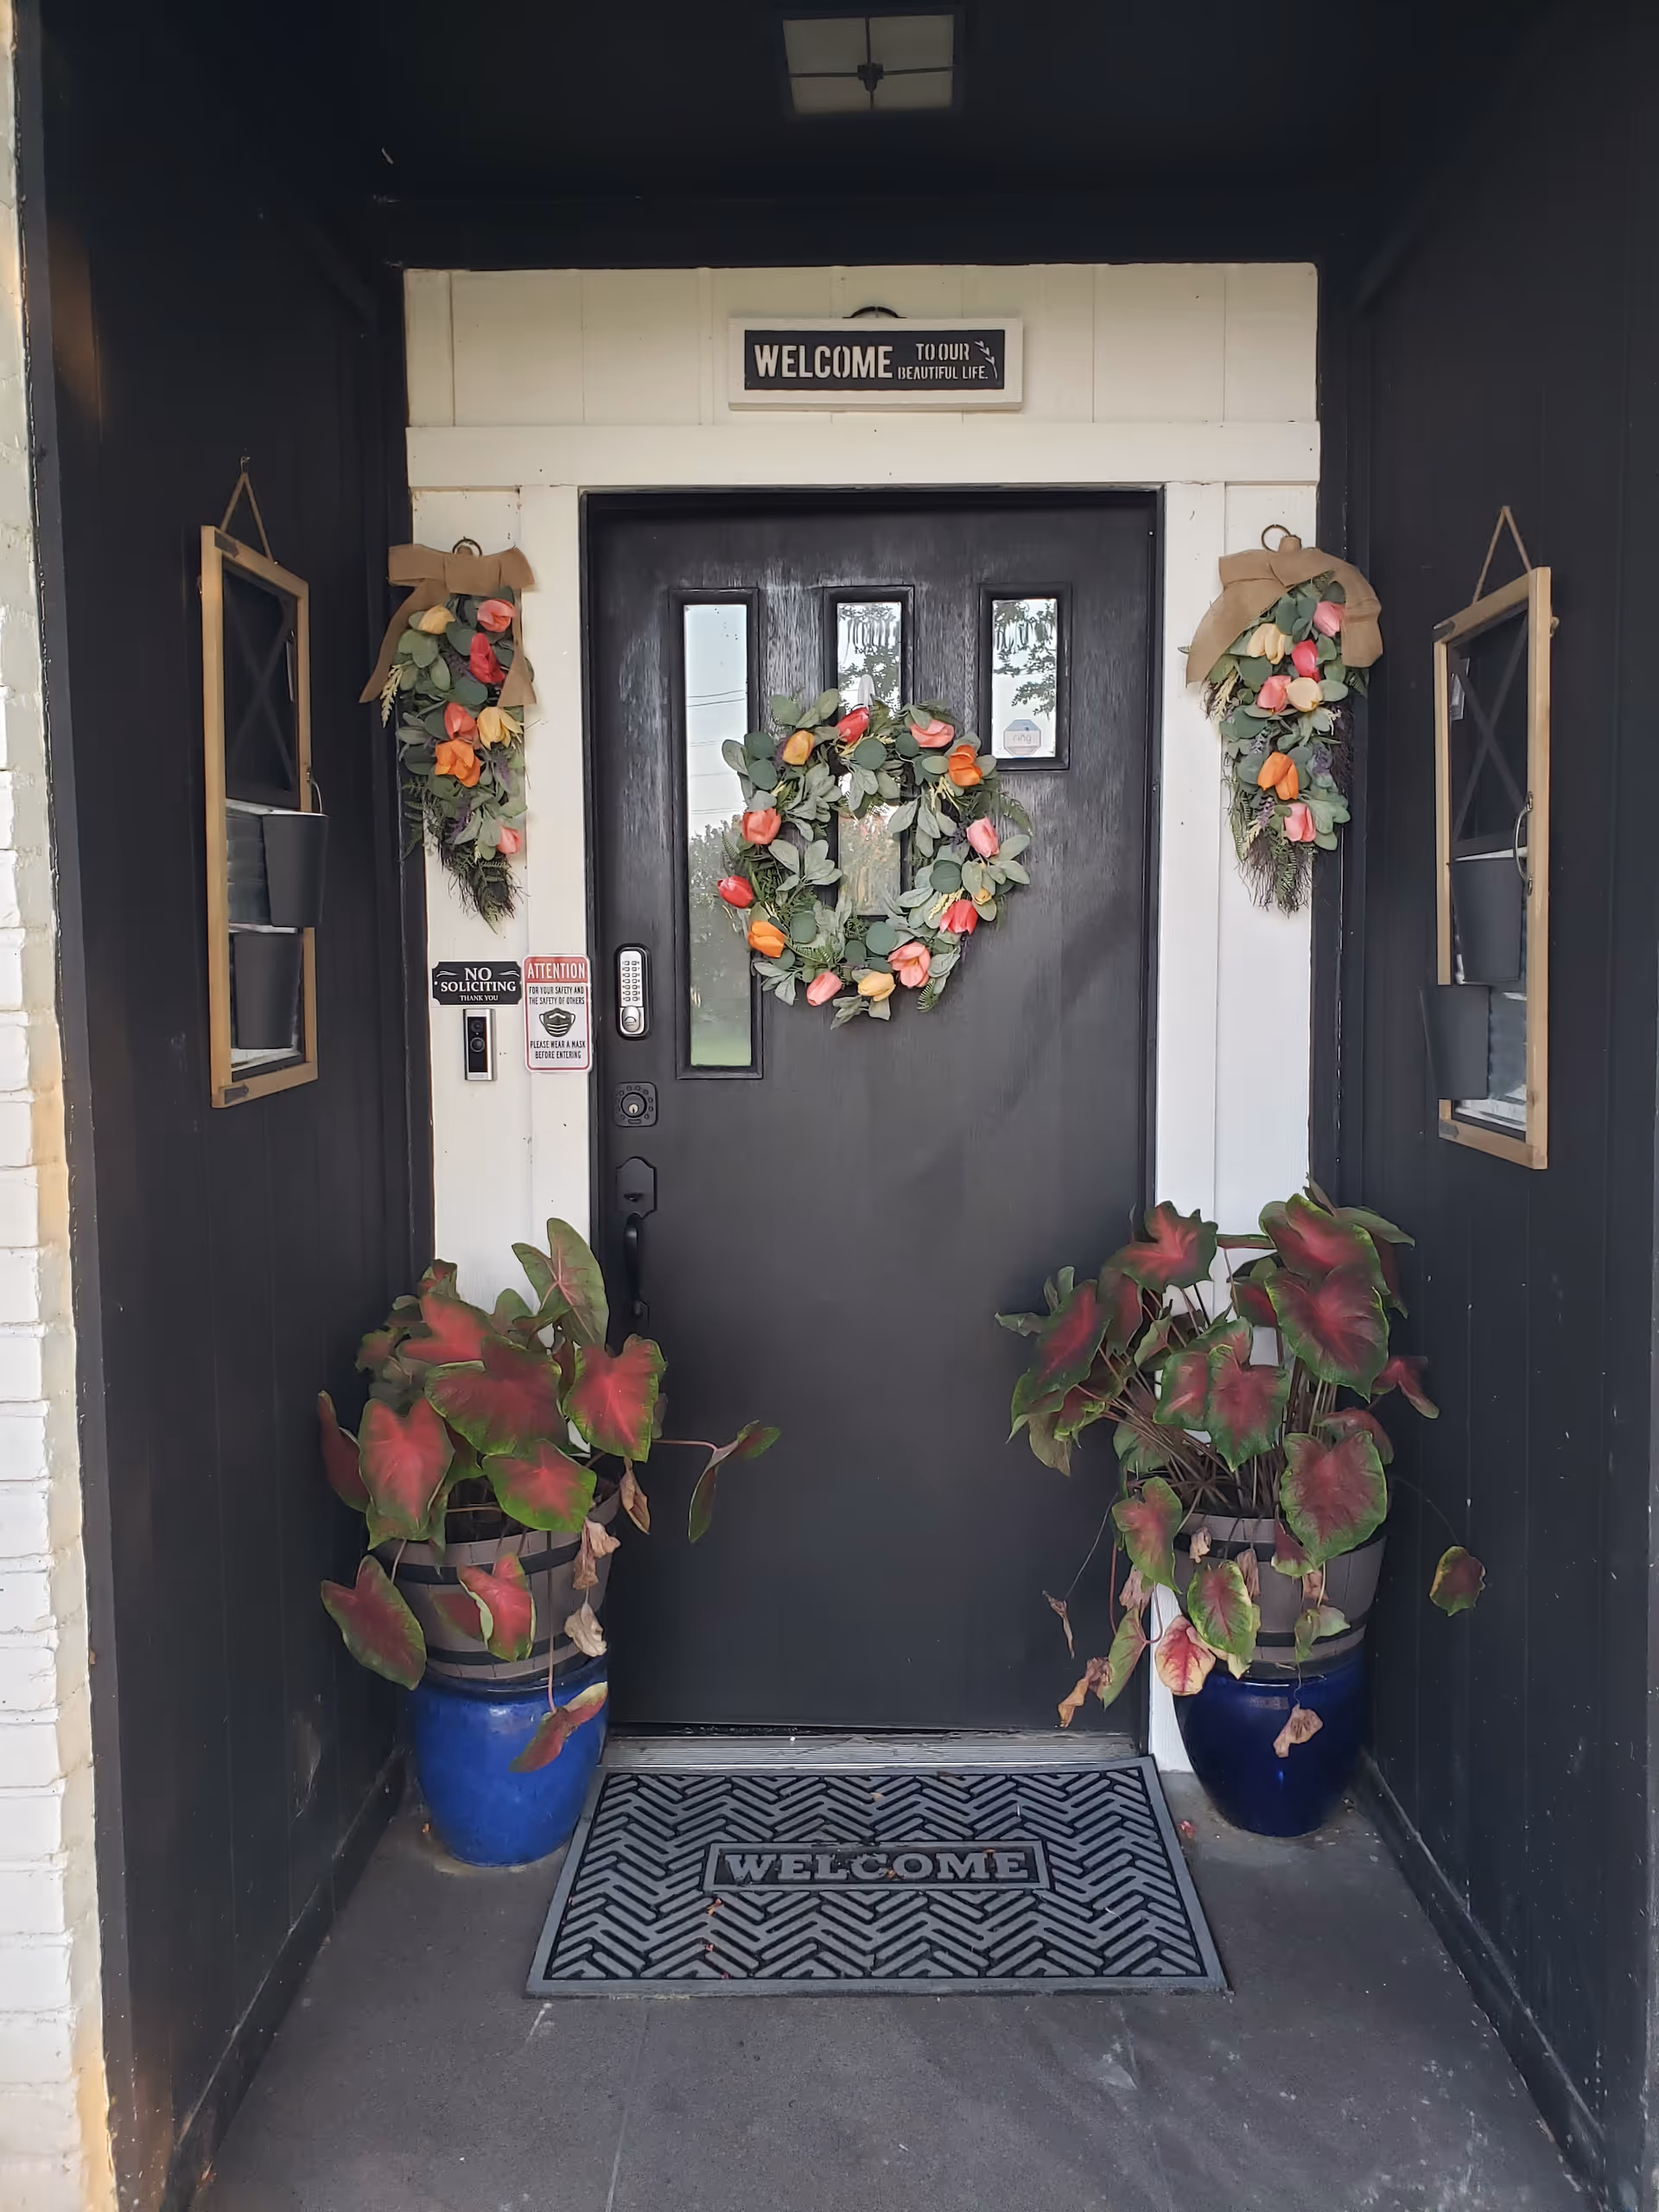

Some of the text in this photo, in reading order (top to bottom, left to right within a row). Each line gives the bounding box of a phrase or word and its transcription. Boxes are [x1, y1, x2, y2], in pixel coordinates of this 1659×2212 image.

[916, 343, 969, 360] TO OUR
[754, 345, 893, 378] WELCOME
[898, 365, 988, 380] BEAUTIFUL LIFE.
[1013, 734, 1032, 744] ring
[464, 967, 493, 982] NO
[527, 963, 585, 979] ATTENTION
[441, 981, 516, 992] SOLICITING
[529, 986, 584, 995] FOR YOUR SAFETY AND
[529, 996, 585, 1005] THE SAFETY OF OTHERS
[536, 1051, 582, 1059] BEFORE ENTERING
[724, 1852, 1028, 1882] WELCOME
